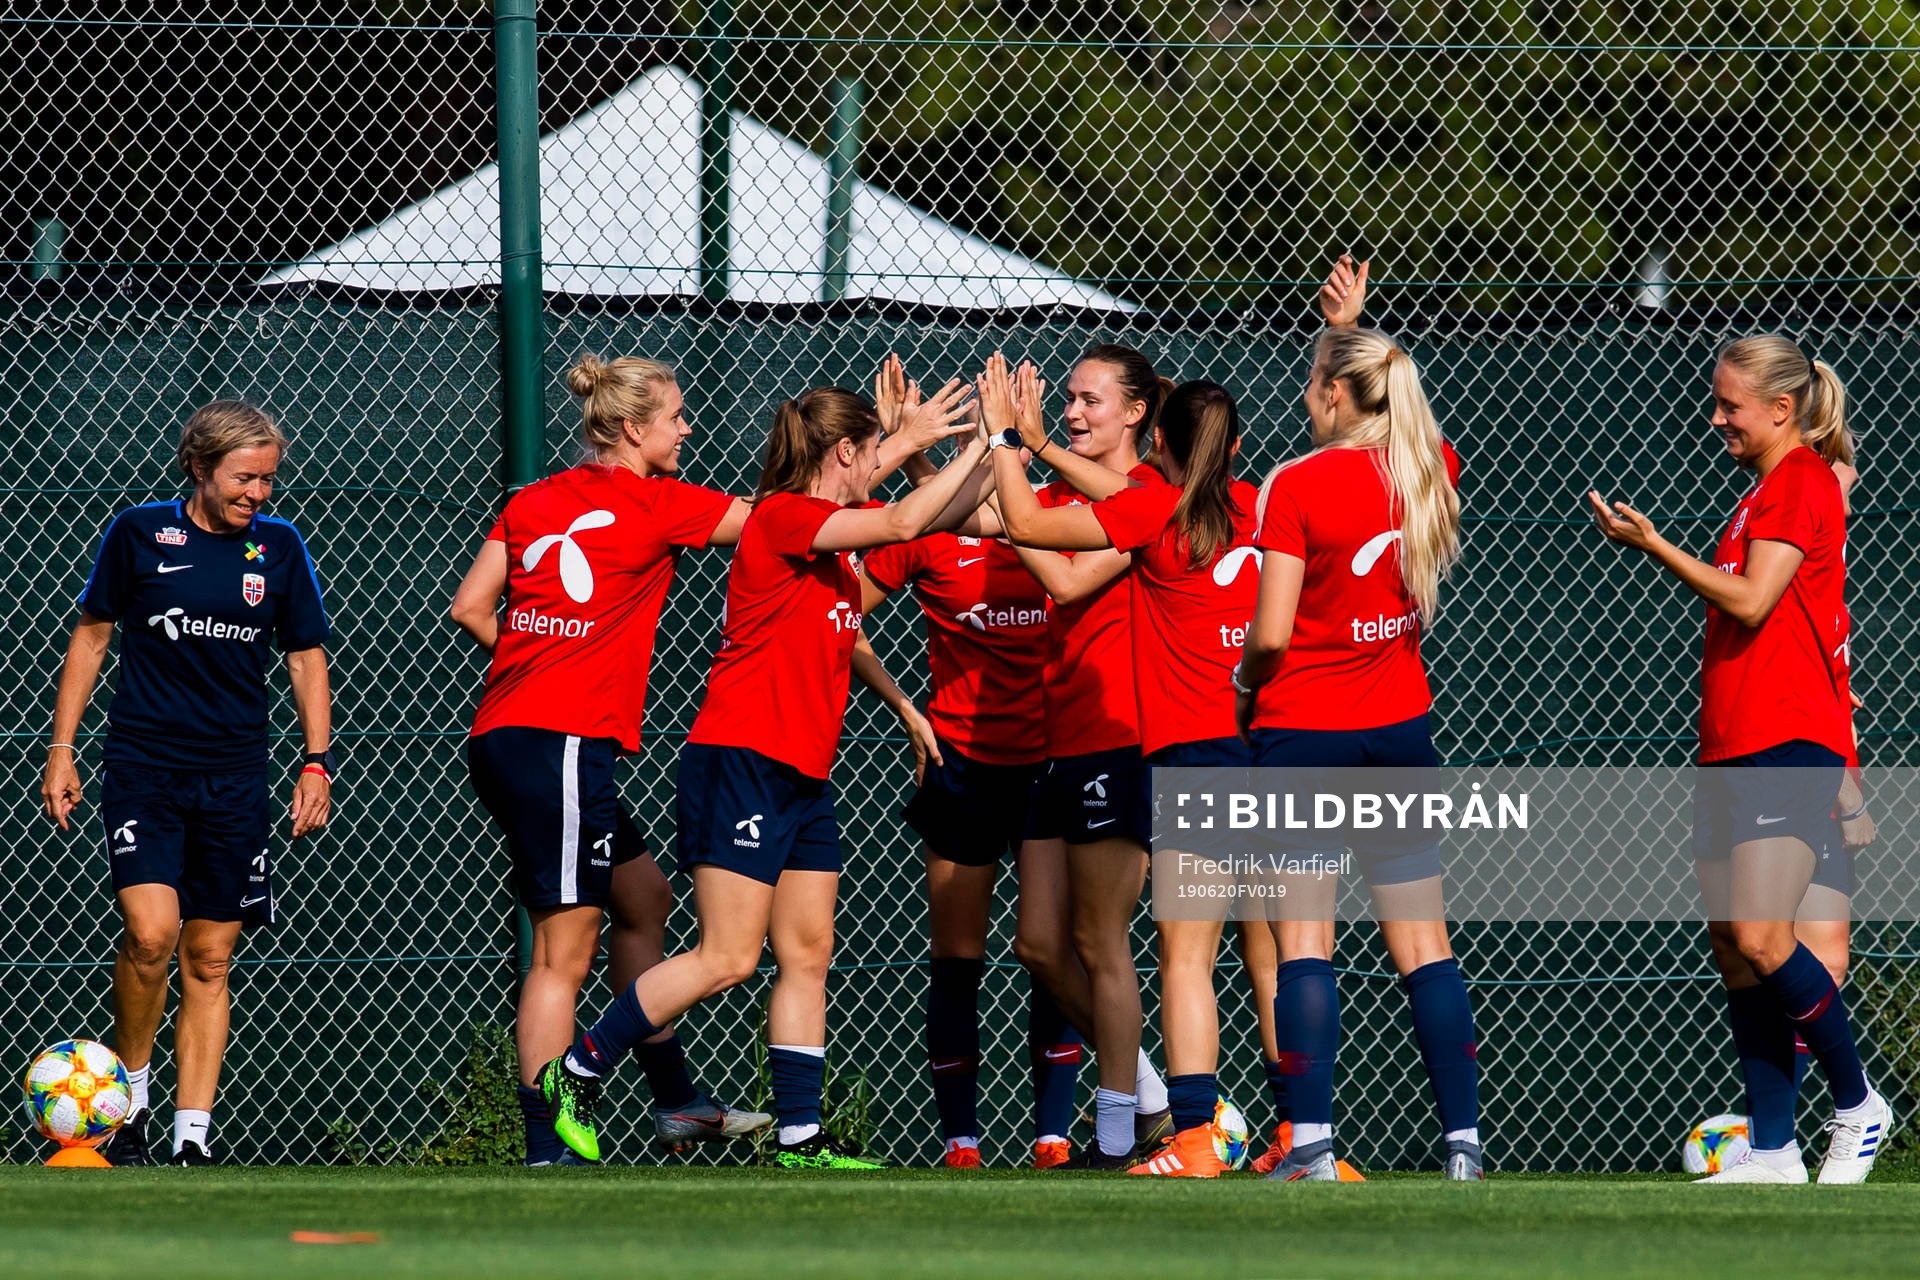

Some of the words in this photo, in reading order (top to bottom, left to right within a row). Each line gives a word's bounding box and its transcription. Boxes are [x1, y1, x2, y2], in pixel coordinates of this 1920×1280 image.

[159, 535, 183, 543] TINE
[511, 608, 595, 638] telenor
[987, 606, 1048, 627] telen
[181, 616, 261, 642] telenor
[734, 838, 760, 848] telenor
